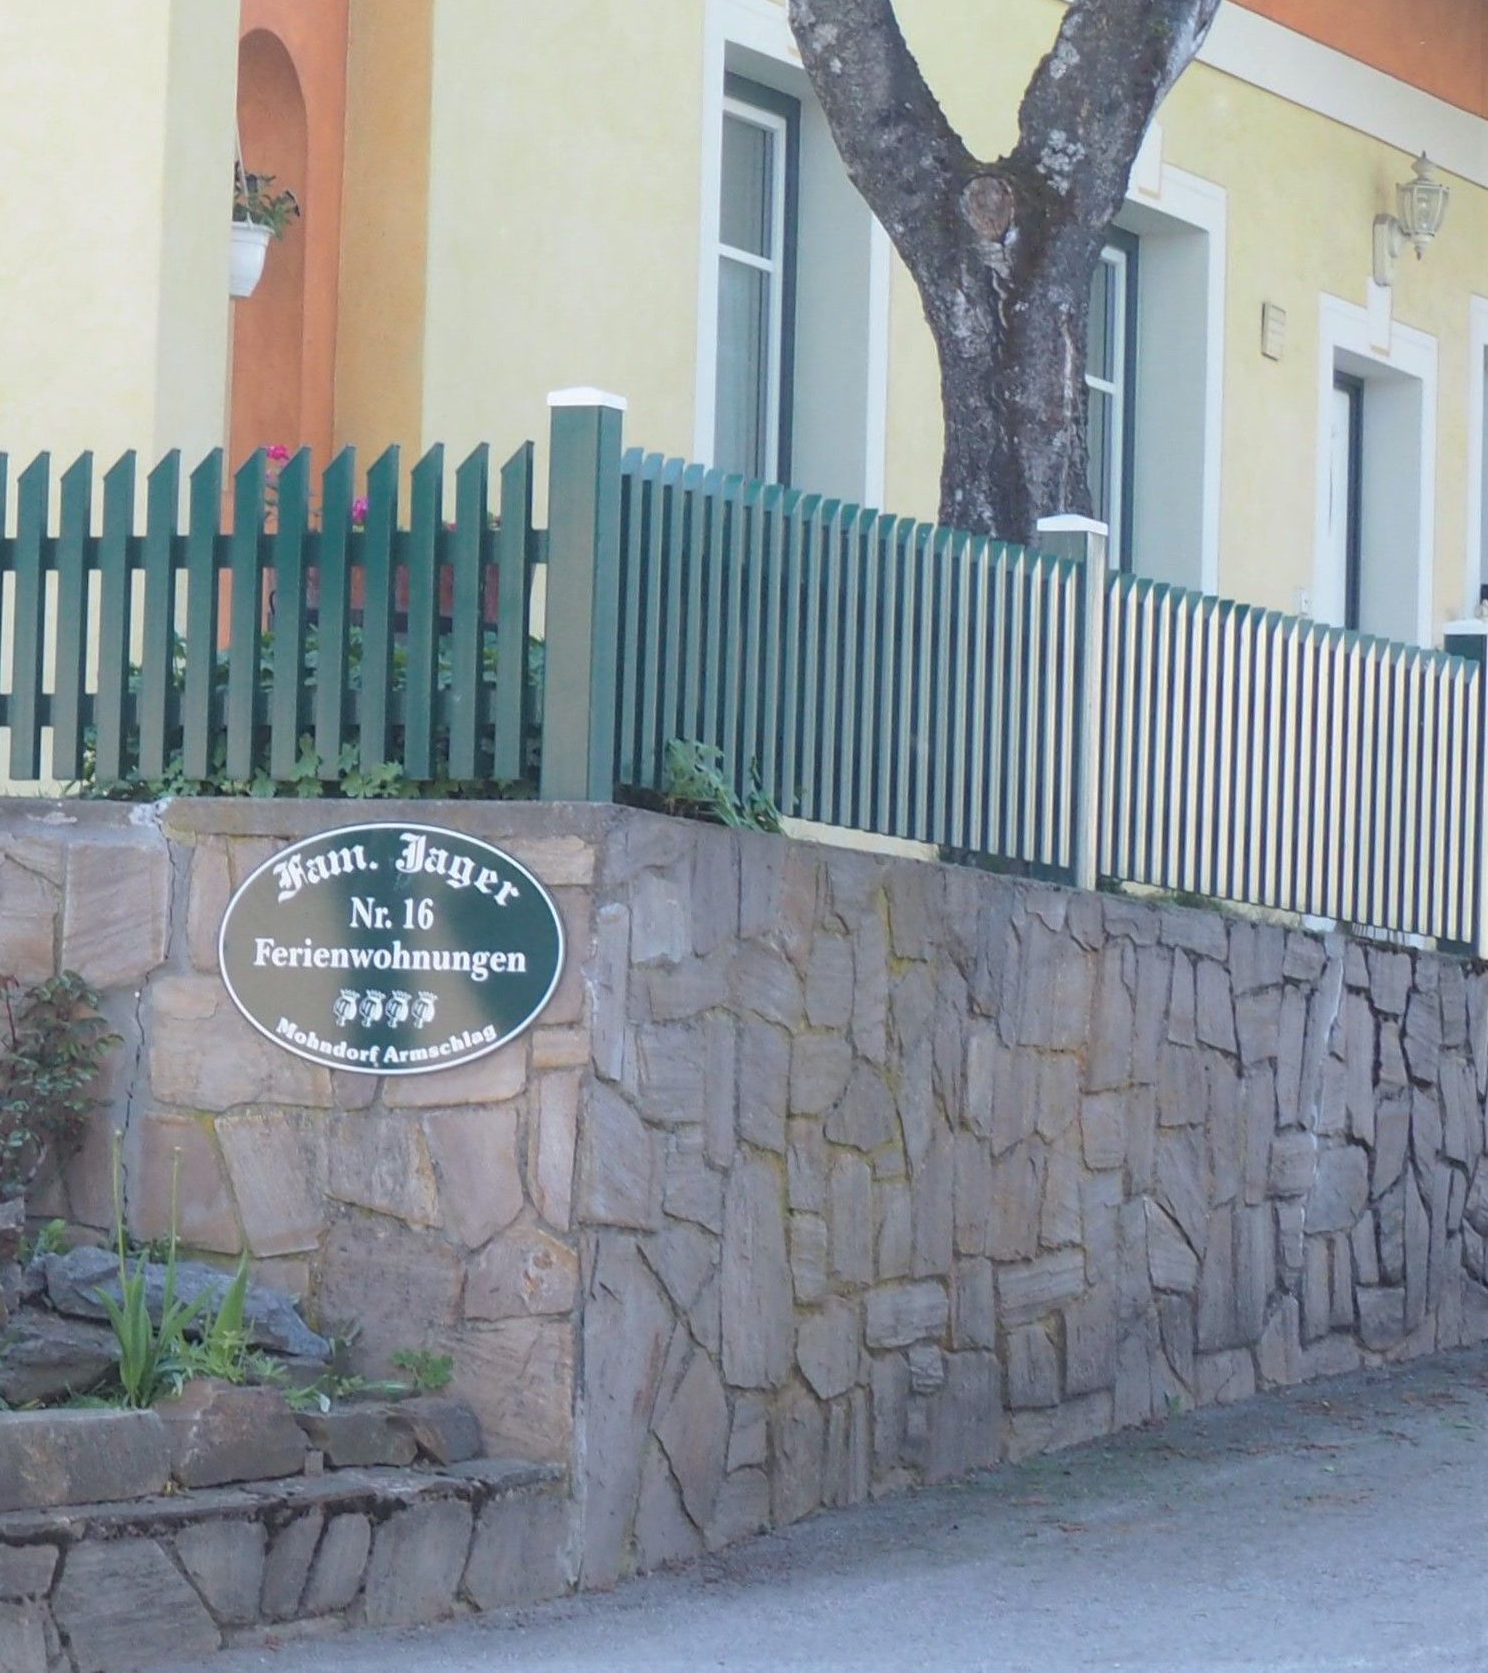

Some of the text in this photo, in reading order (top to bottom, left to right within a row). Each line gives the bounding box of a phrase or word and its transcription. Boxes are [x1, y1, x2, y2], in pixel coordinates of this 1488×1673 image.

[273, 844, 379, 903] Fam.
[350, 896, 435, 930] Nr. 16
[253, 938, 527, 982] Ferienwohnungen
[275, 1017, 497, 1064] Mohndorf Armschlag
